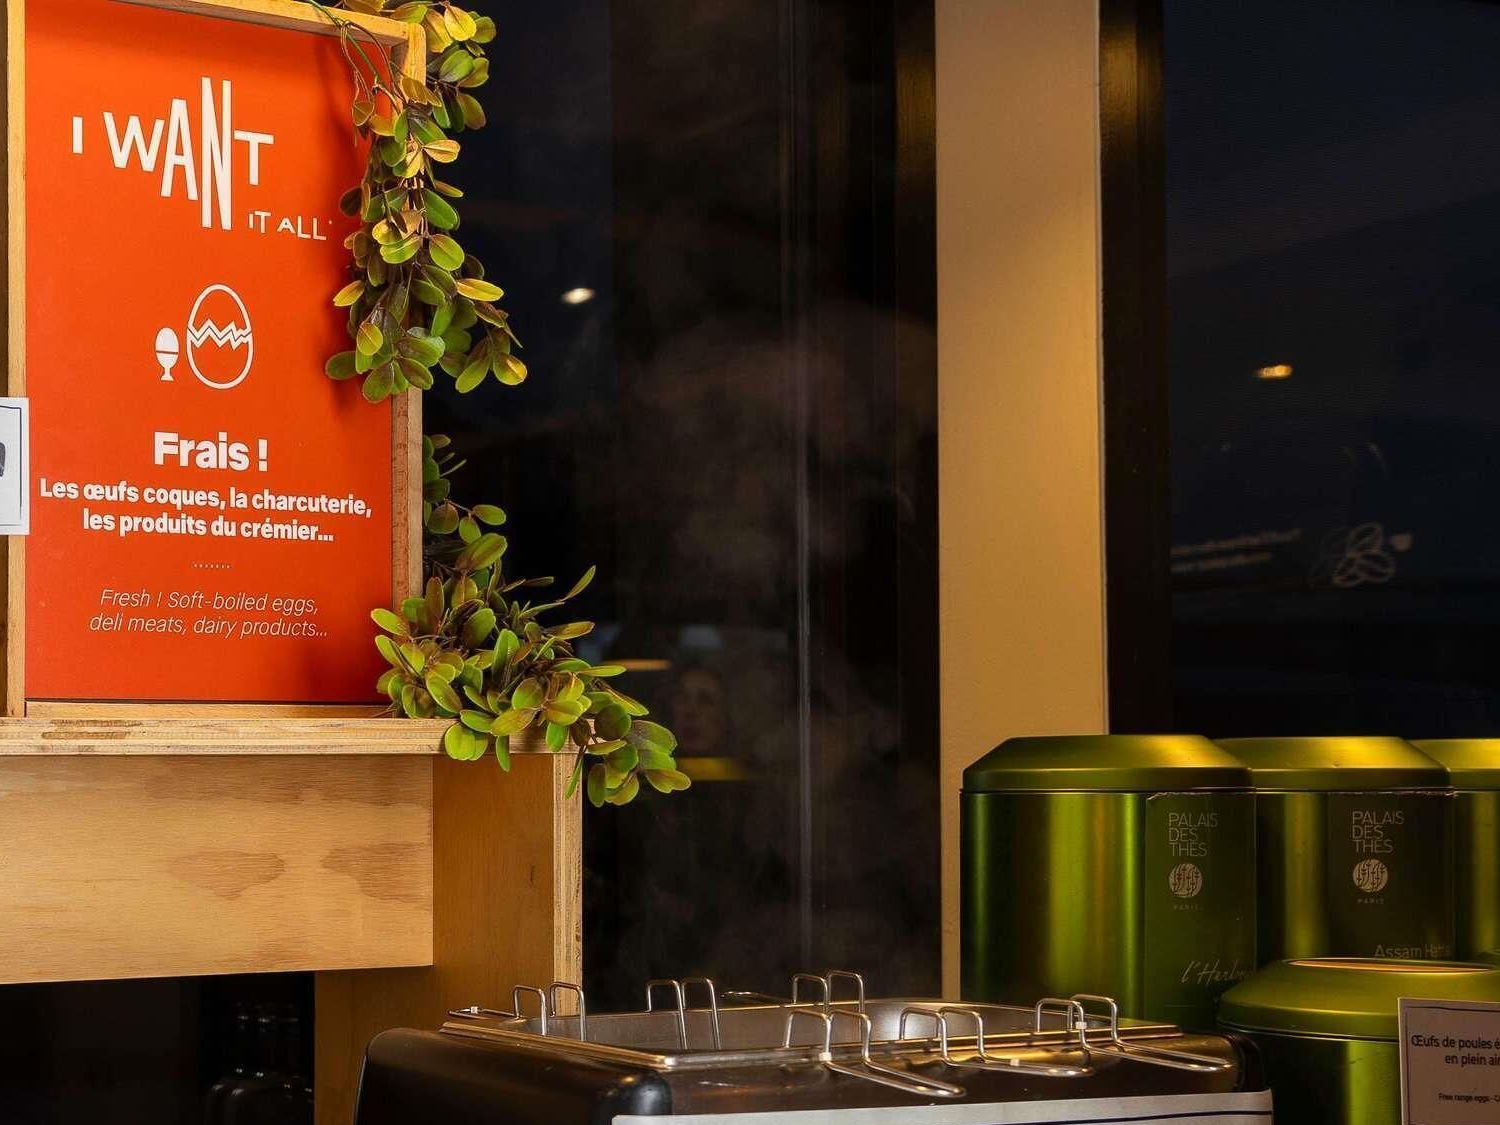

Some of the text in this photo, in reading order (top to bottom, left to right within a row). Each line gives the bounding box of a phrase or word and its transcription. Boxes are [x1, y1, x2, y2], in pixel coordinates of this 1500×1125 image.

[72, 76, 275, 231] I WANT
[248, 210, 327, 241] IT ALL
[153, 431, 269, 473] Frais !
[39, 477, 79, 500] Les
[143, 486, 226, 513] coques,
[229, 486, 248, 509] la
[252, 488, 373, 519] charcuterie,
[83, 507, 116, 531] les
[119, 510, 208, 538] produits
[210, 513, 237, 538] du
[100, 588, 152, 608] Fresh
[167, 589, 269, 613] Soft-boiled
[272, 596, 319, 618] eggs,
[89, 612, 124, 633] deli
[126, 614, 188, 636] meats,
[192, 616, 236, 640] dairy
[1167, 812, 1219, 828] PALAIS
[1351, 810, 1405, 826] PALAIS
[1167, 827, 1199, 843] DES
[1351, 825, 1384, 841] DES
[1441, 1036, 1456, 1048] de
[1457, 1037, 1493, 1051] poules
[1444, 1054, 1459, 1065] en
[1460, 1052, 1487, 1068] plein
